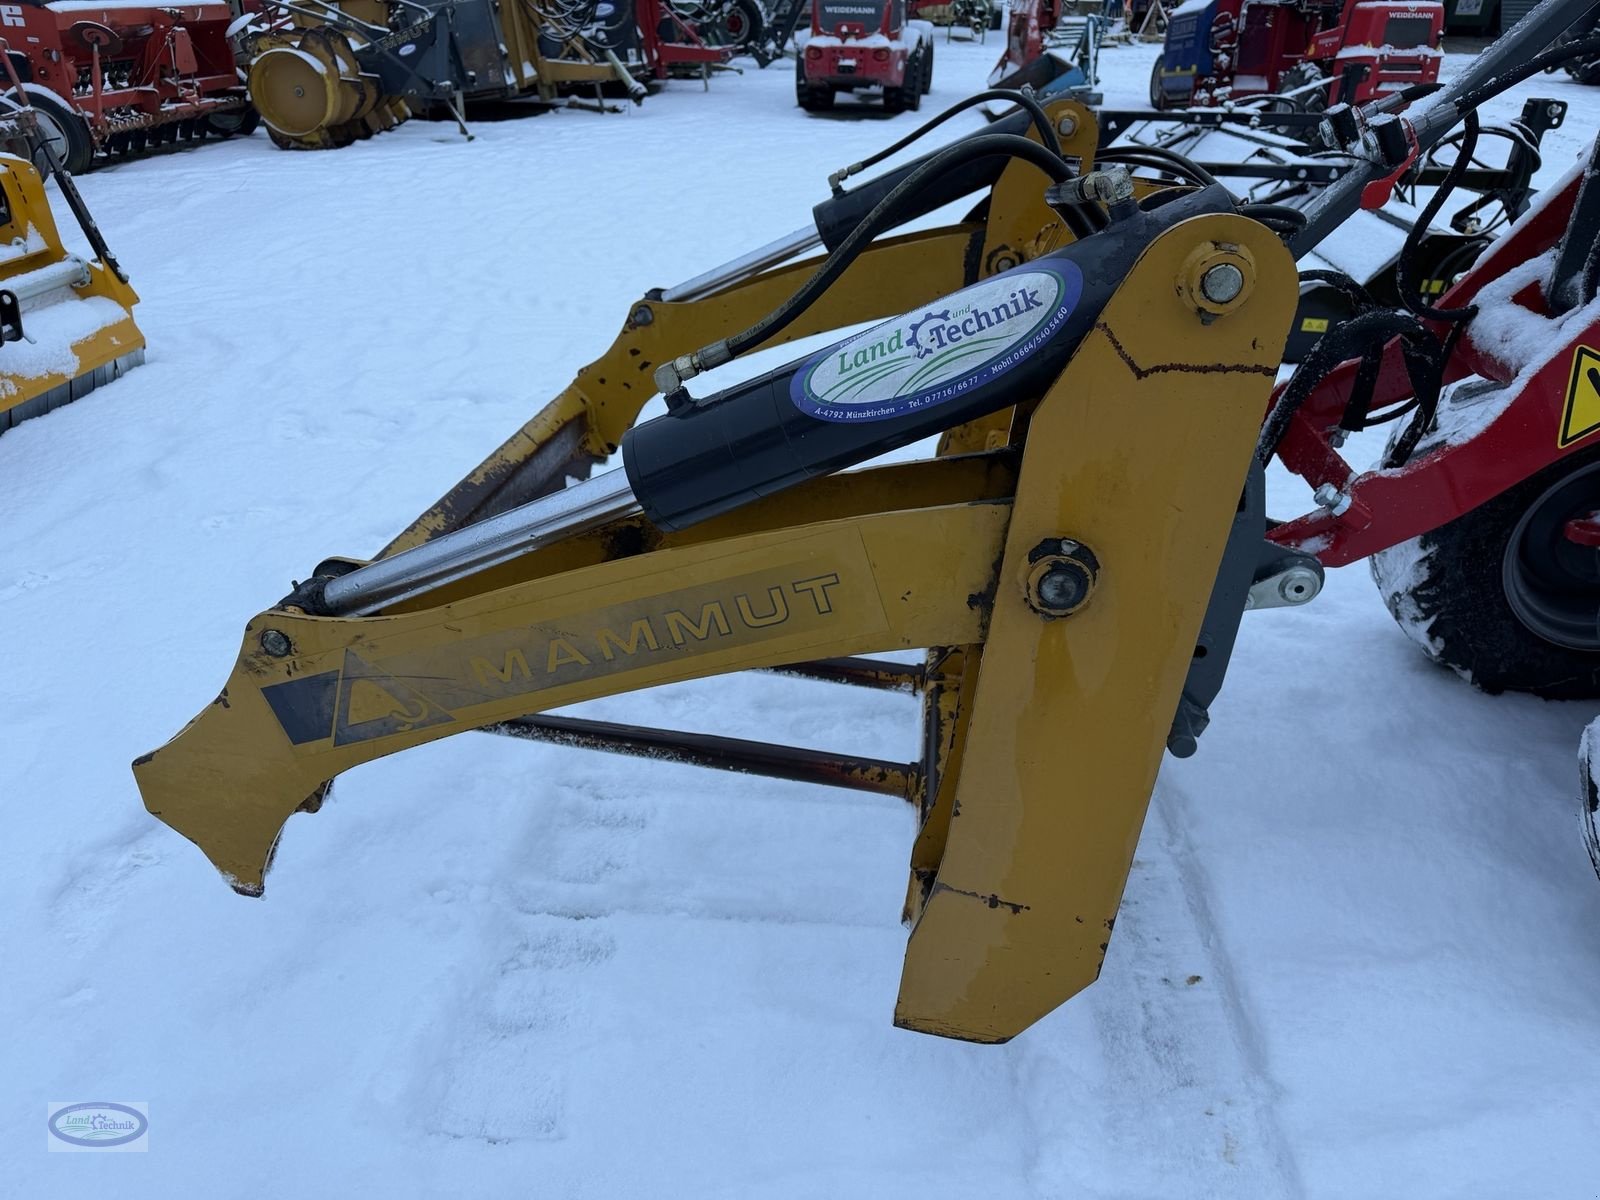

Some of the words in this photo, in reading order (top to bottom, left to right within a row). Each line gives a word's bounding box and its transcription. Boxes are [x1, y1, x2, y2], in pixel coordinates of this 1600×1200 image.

[825, 6, 876, 14] WEIDEMANN
[1389, 11, 1434, 19] WEIDEMANN
[929, 288, 1044, 349] Technik
[952, 304, 971, 319] und
[838, 328, 903, 376] Land
[814, 407, 844, 419] A-4792
[845, 407, 896, 420] Münzkirchen
[908, 399, 923, 409] Tel.
[991, 356, 1013, 375] Mobil
[469, 572, 841, 689] MAMMUT
